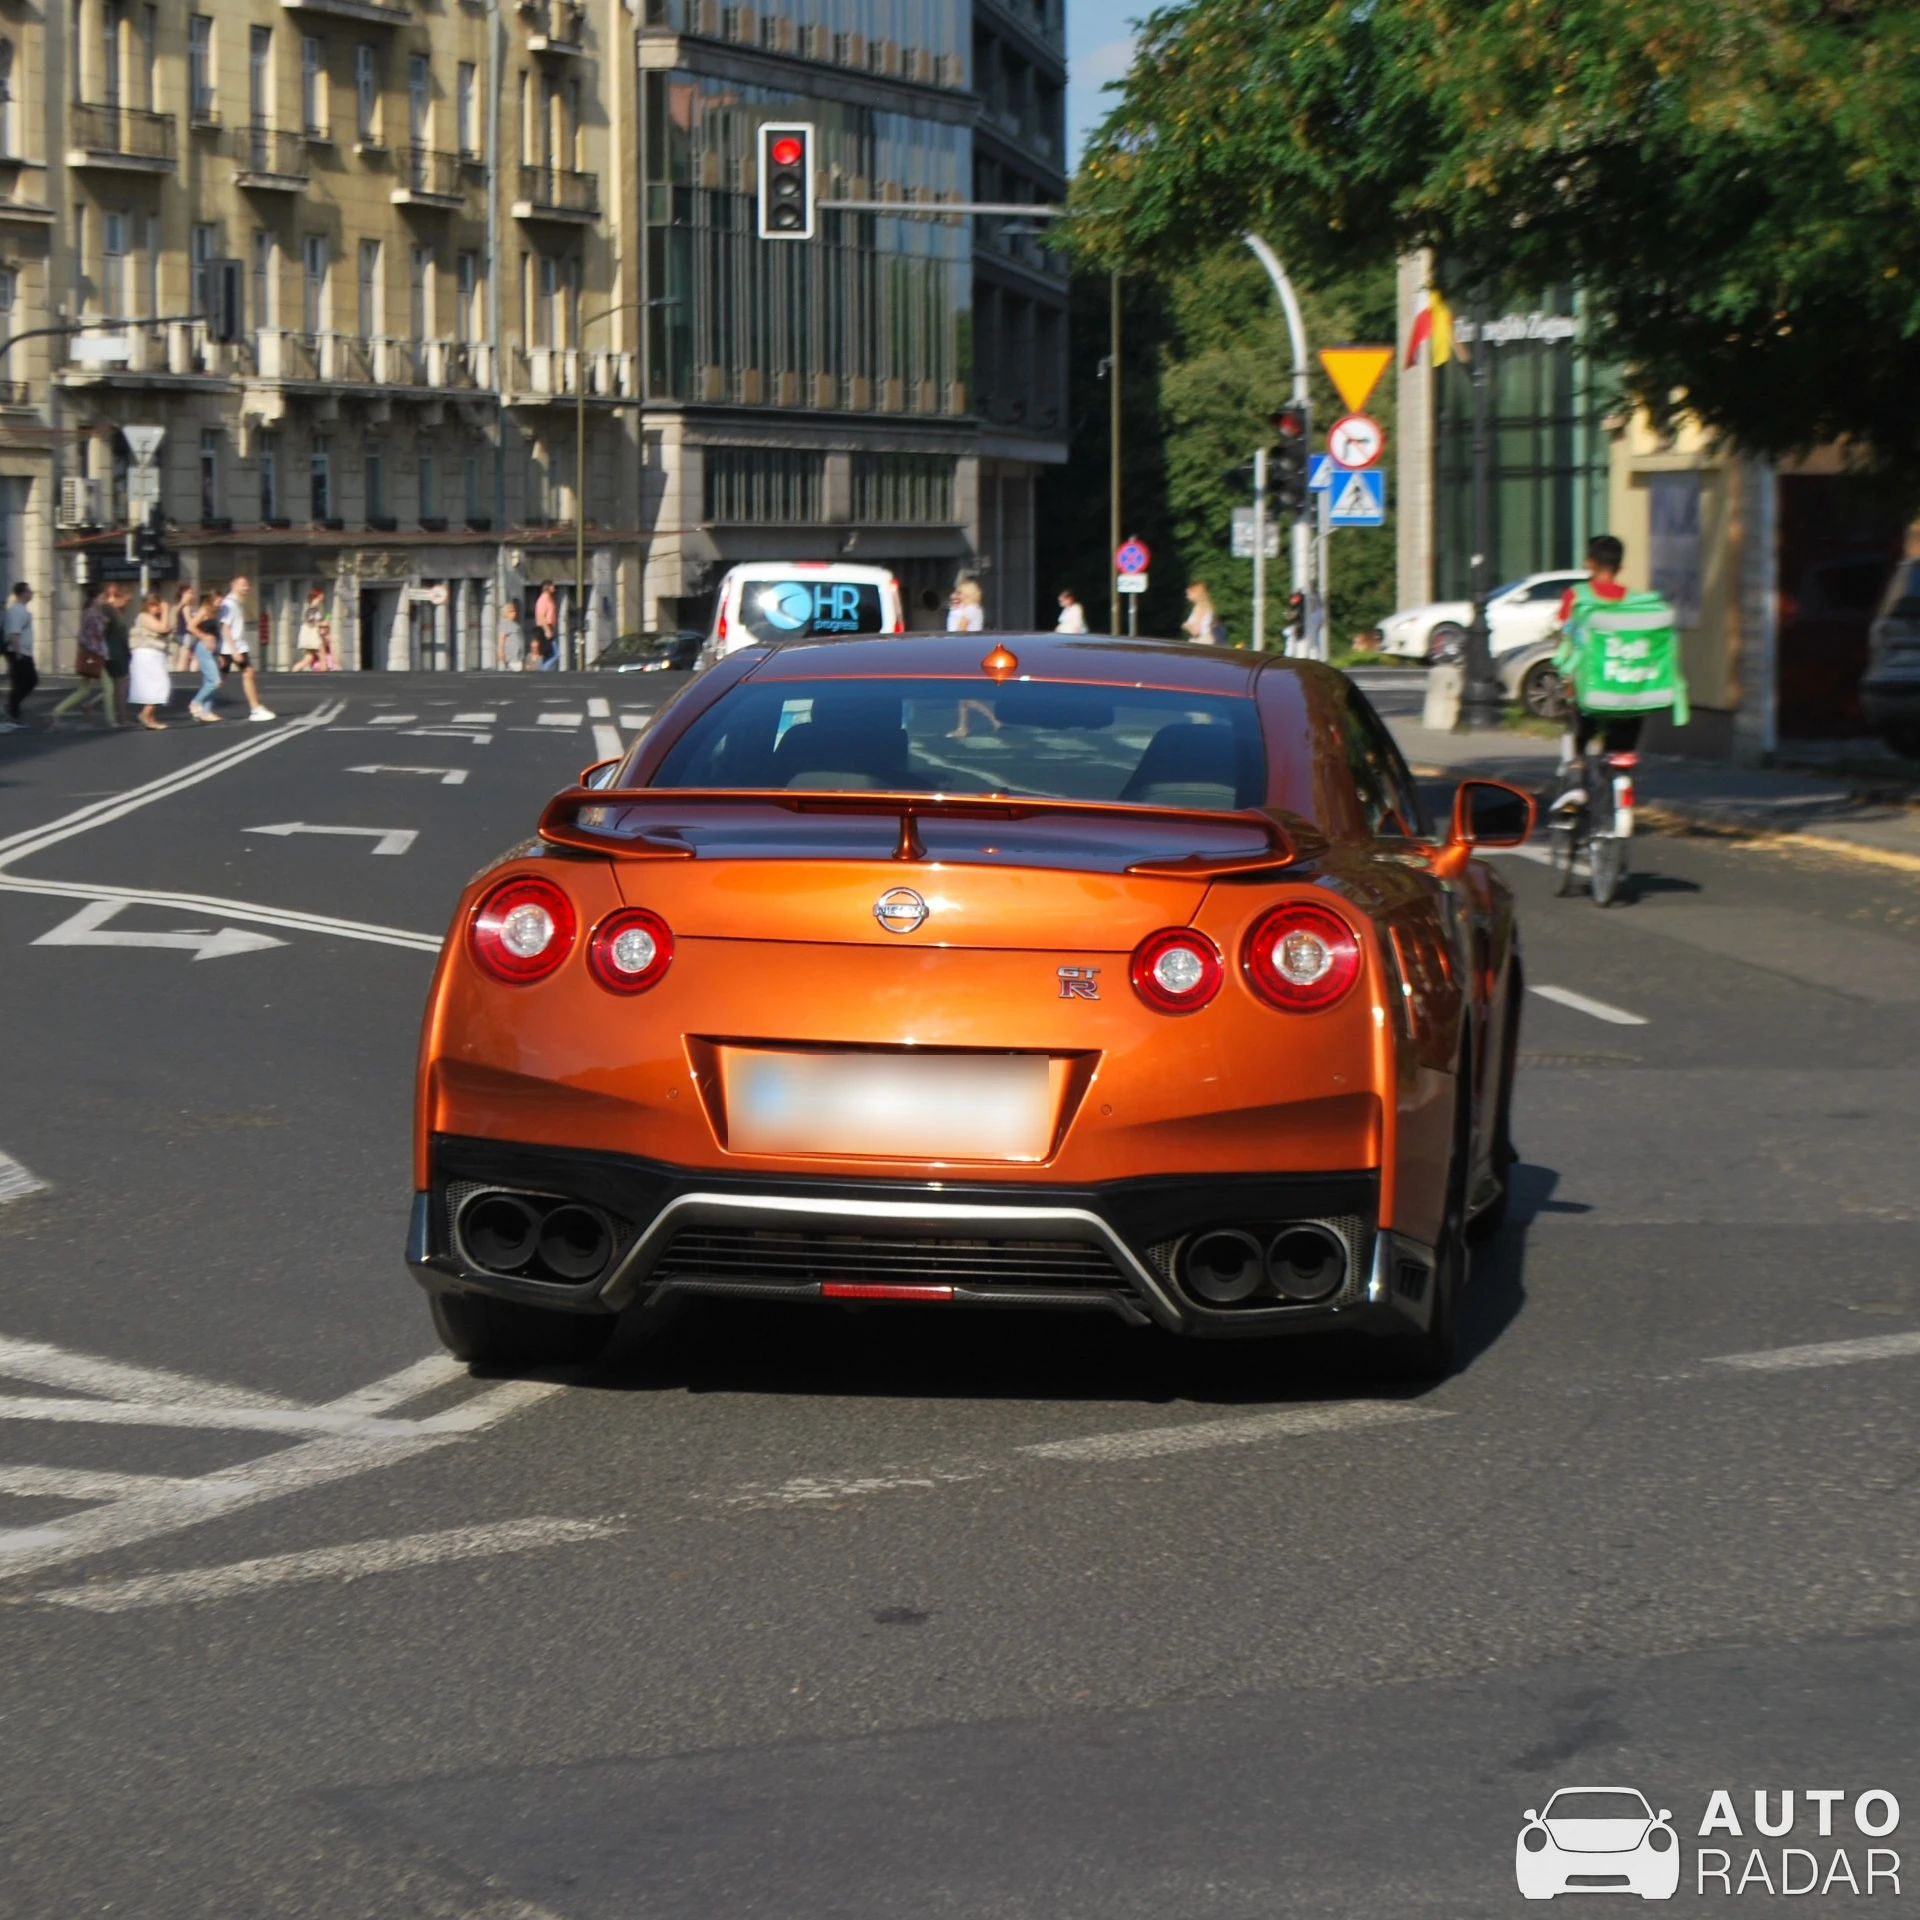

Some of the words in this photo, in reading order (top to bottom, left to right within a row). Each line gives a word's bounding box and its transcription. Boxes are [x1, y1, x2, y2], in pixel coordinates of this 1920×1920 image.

[813, 584, 860, 620] HR
[813, 620, 859, 632] progress
[878, 906, 923, 915] NISN
[1057, 967, 1101, 979] GT
[1058, 979, 1101, 1000] R
